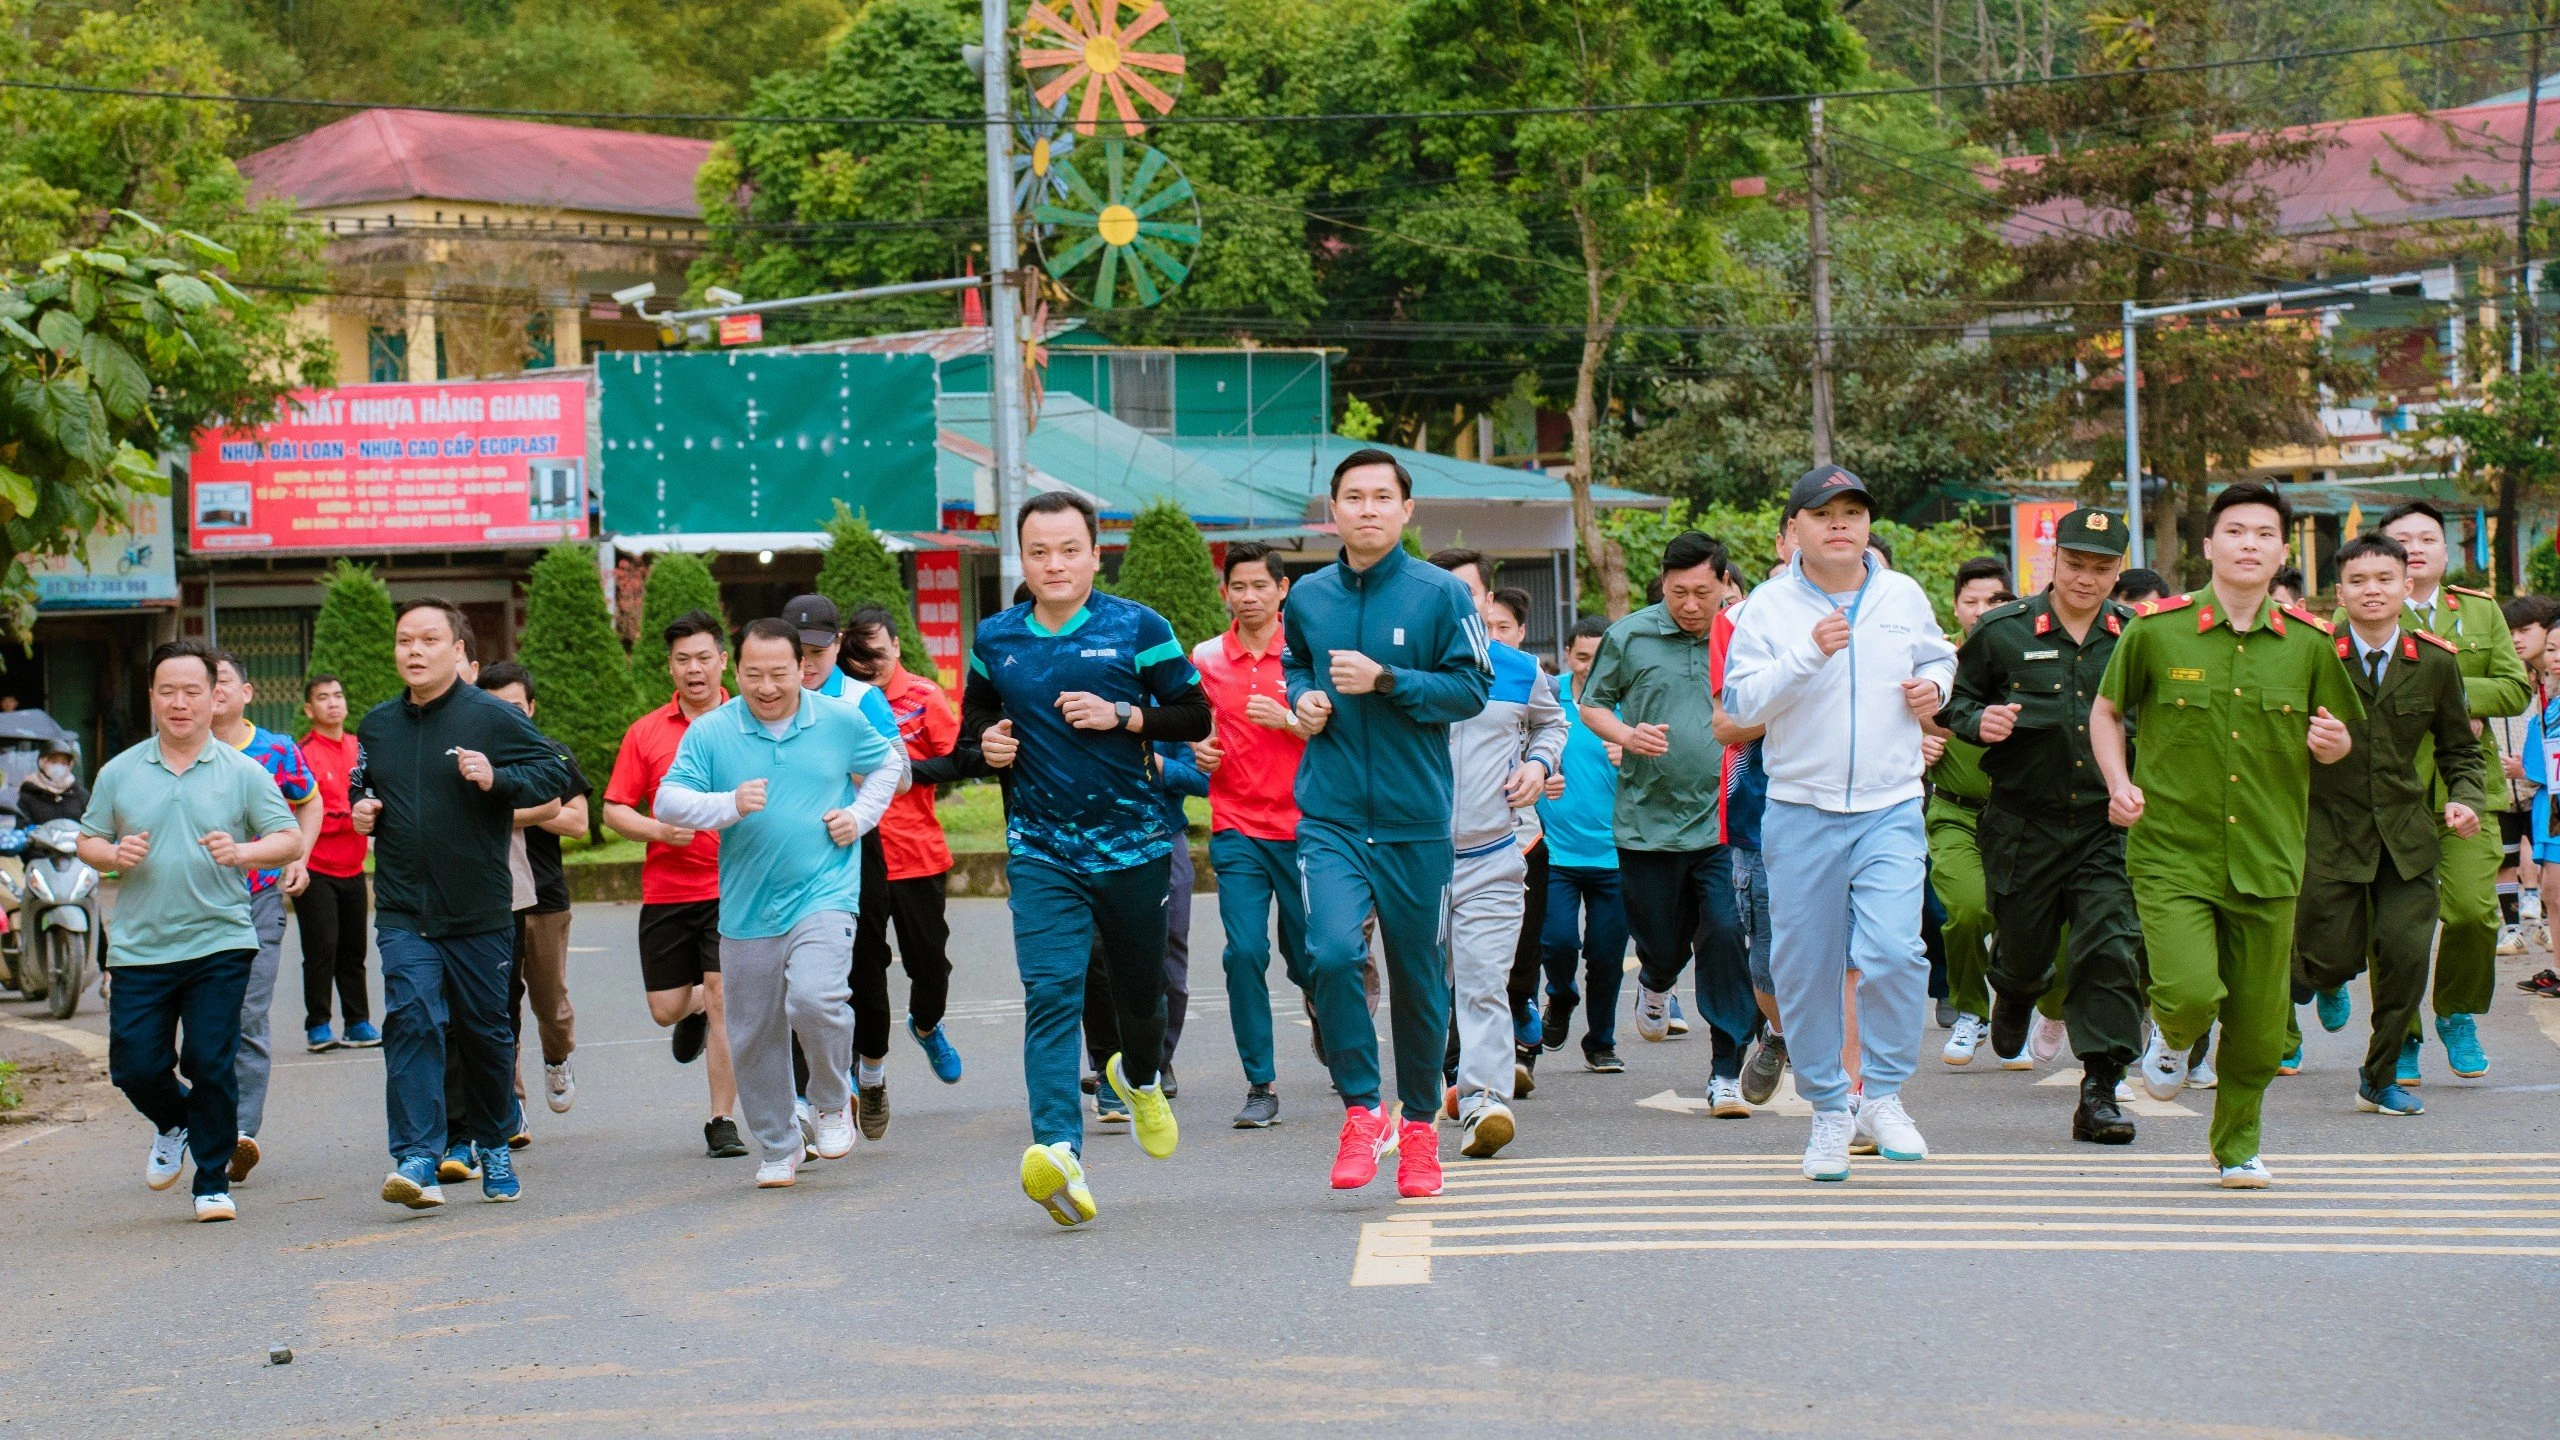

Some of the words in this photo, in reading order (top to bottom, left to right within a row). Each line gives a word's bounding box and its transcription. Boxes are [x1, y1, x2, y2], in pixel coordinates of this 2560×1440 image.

[351, 397, 415, 430] NHỰA
[489, 394, 561, 422] GIANG
[302, 441, 344, 459] LOAN
[359, 440, 404, 462] NHỰA
[407, 438, 439, 458] CAO
[478, 435, 558, 456] ECOPLAST
